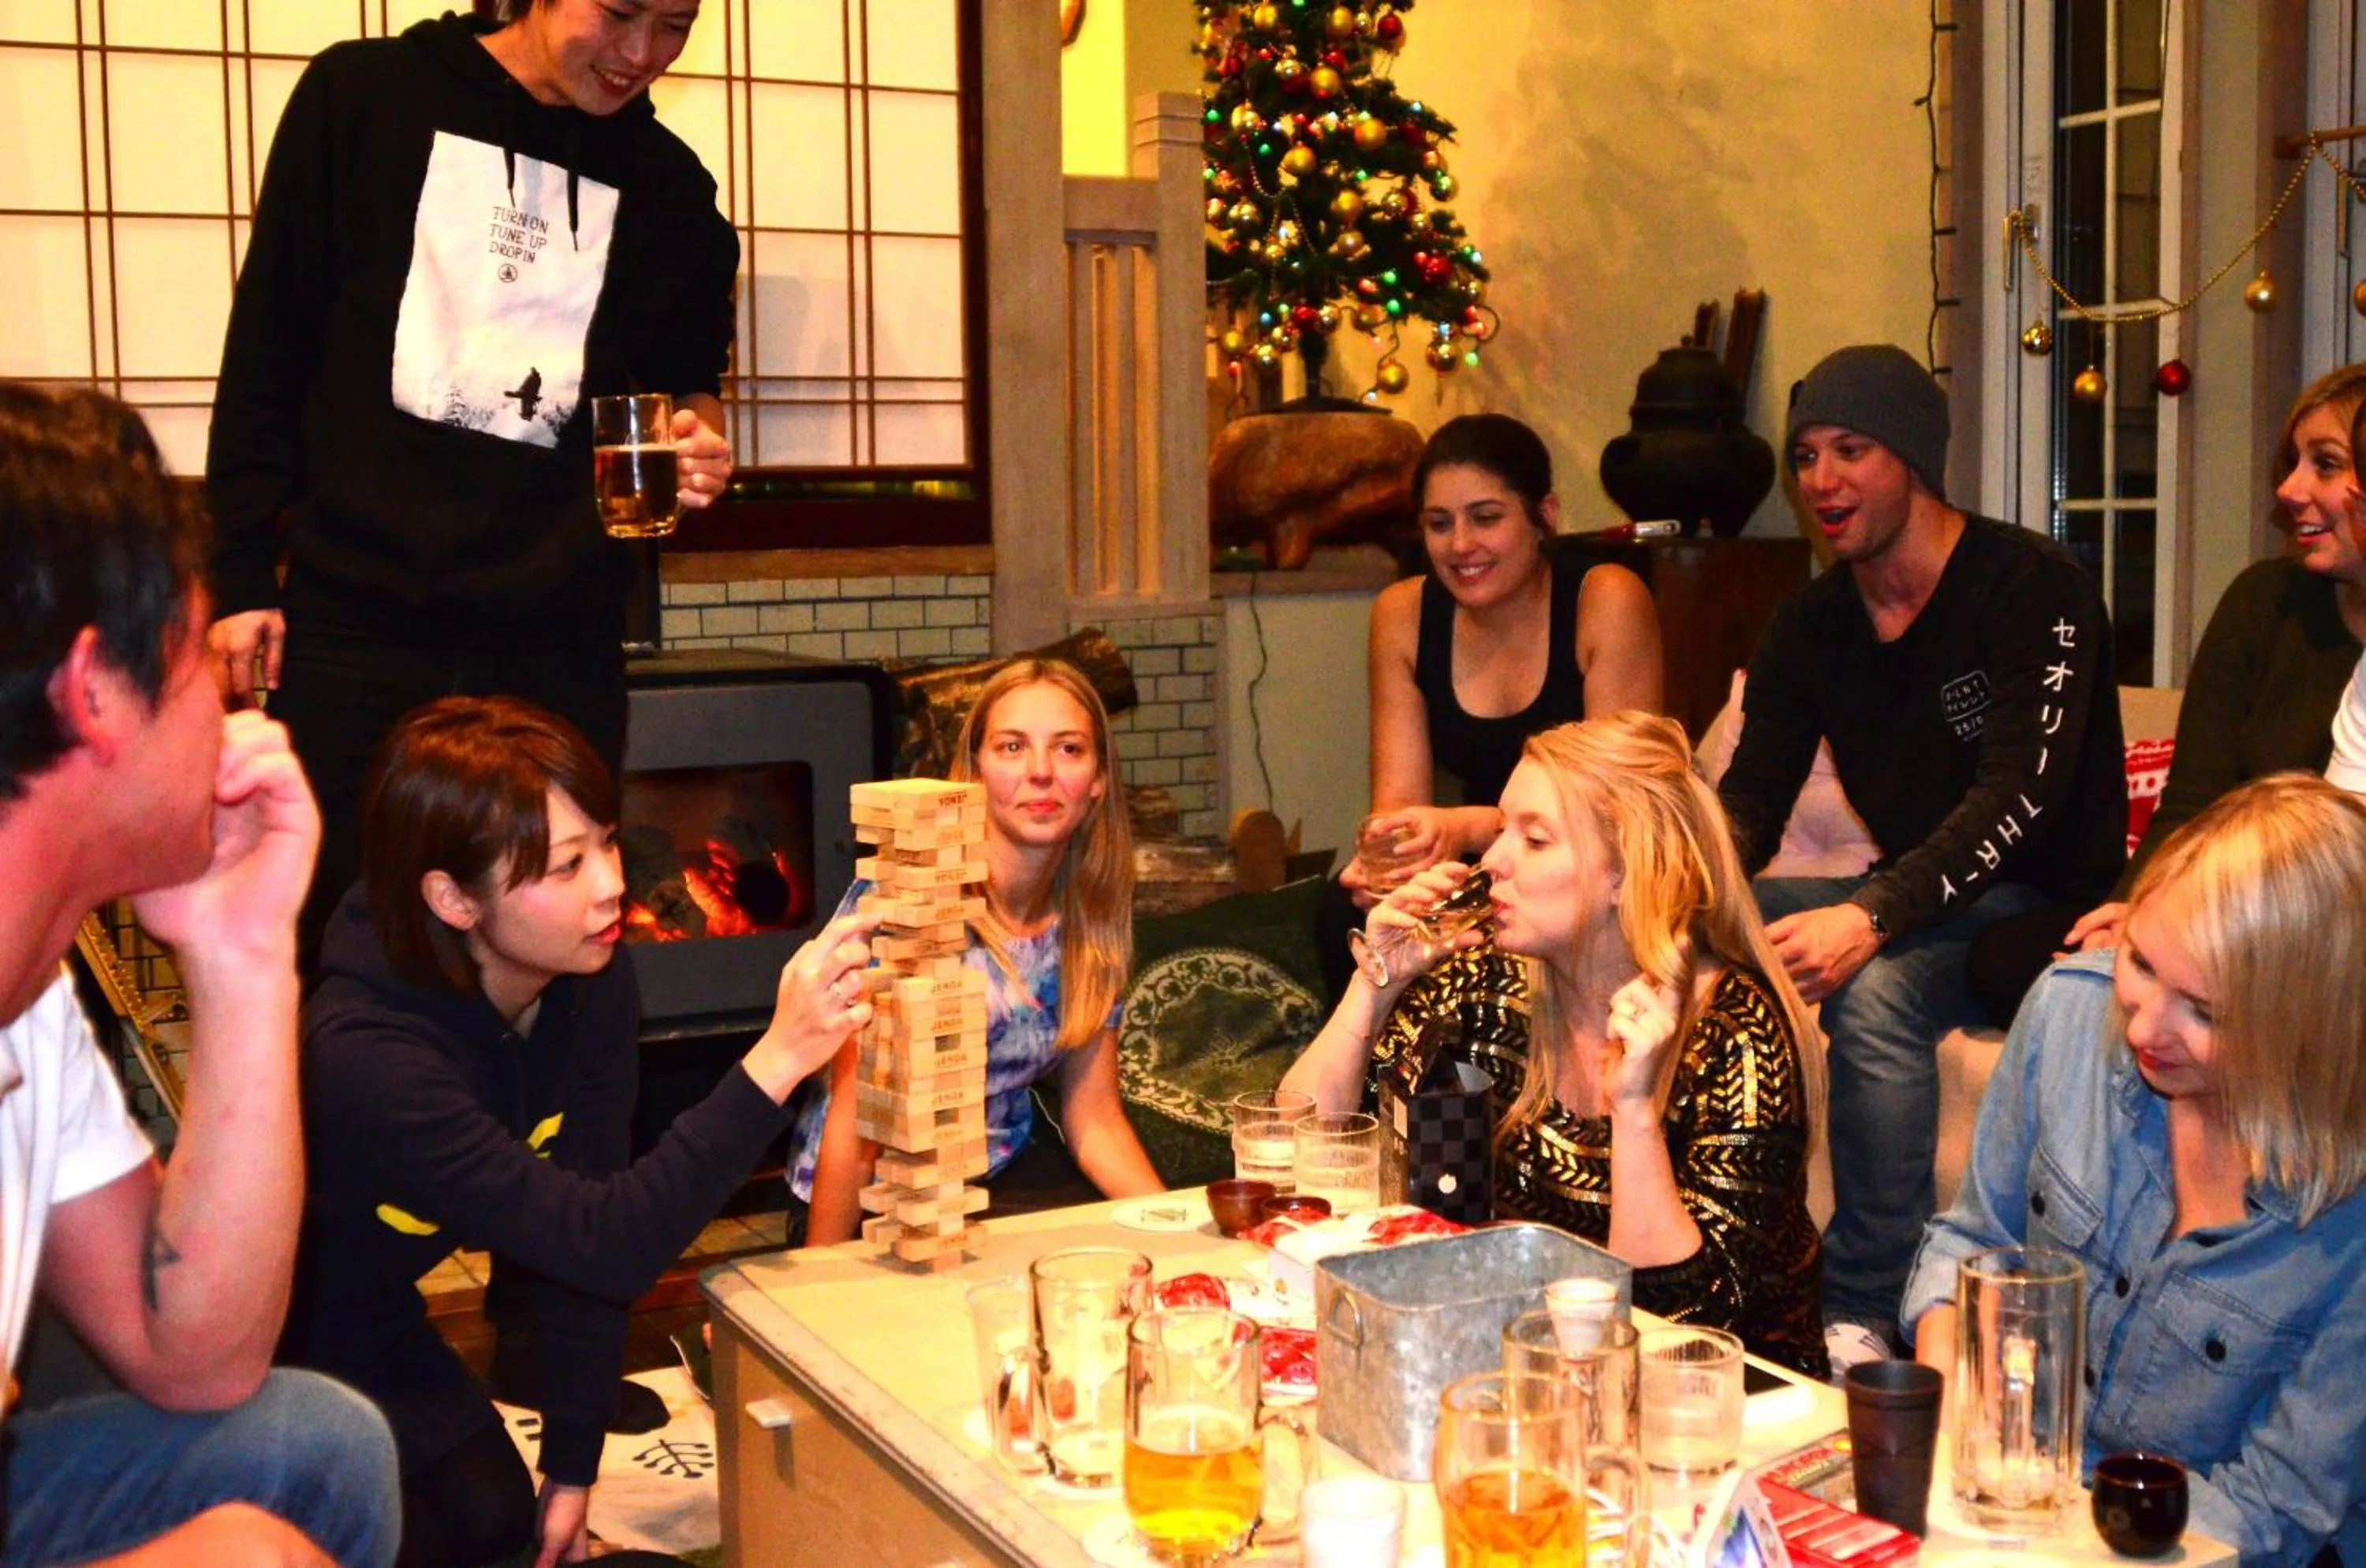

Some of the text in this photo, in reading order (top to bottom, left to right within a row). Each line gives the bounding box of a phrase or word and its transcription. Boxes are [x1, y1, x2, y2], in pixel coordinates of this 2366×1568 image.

[492, 206, 550, 235] TURN ON
[489, 223, 547, 251] TUNE UP
[489, 241, 536, 263] DROP IN
